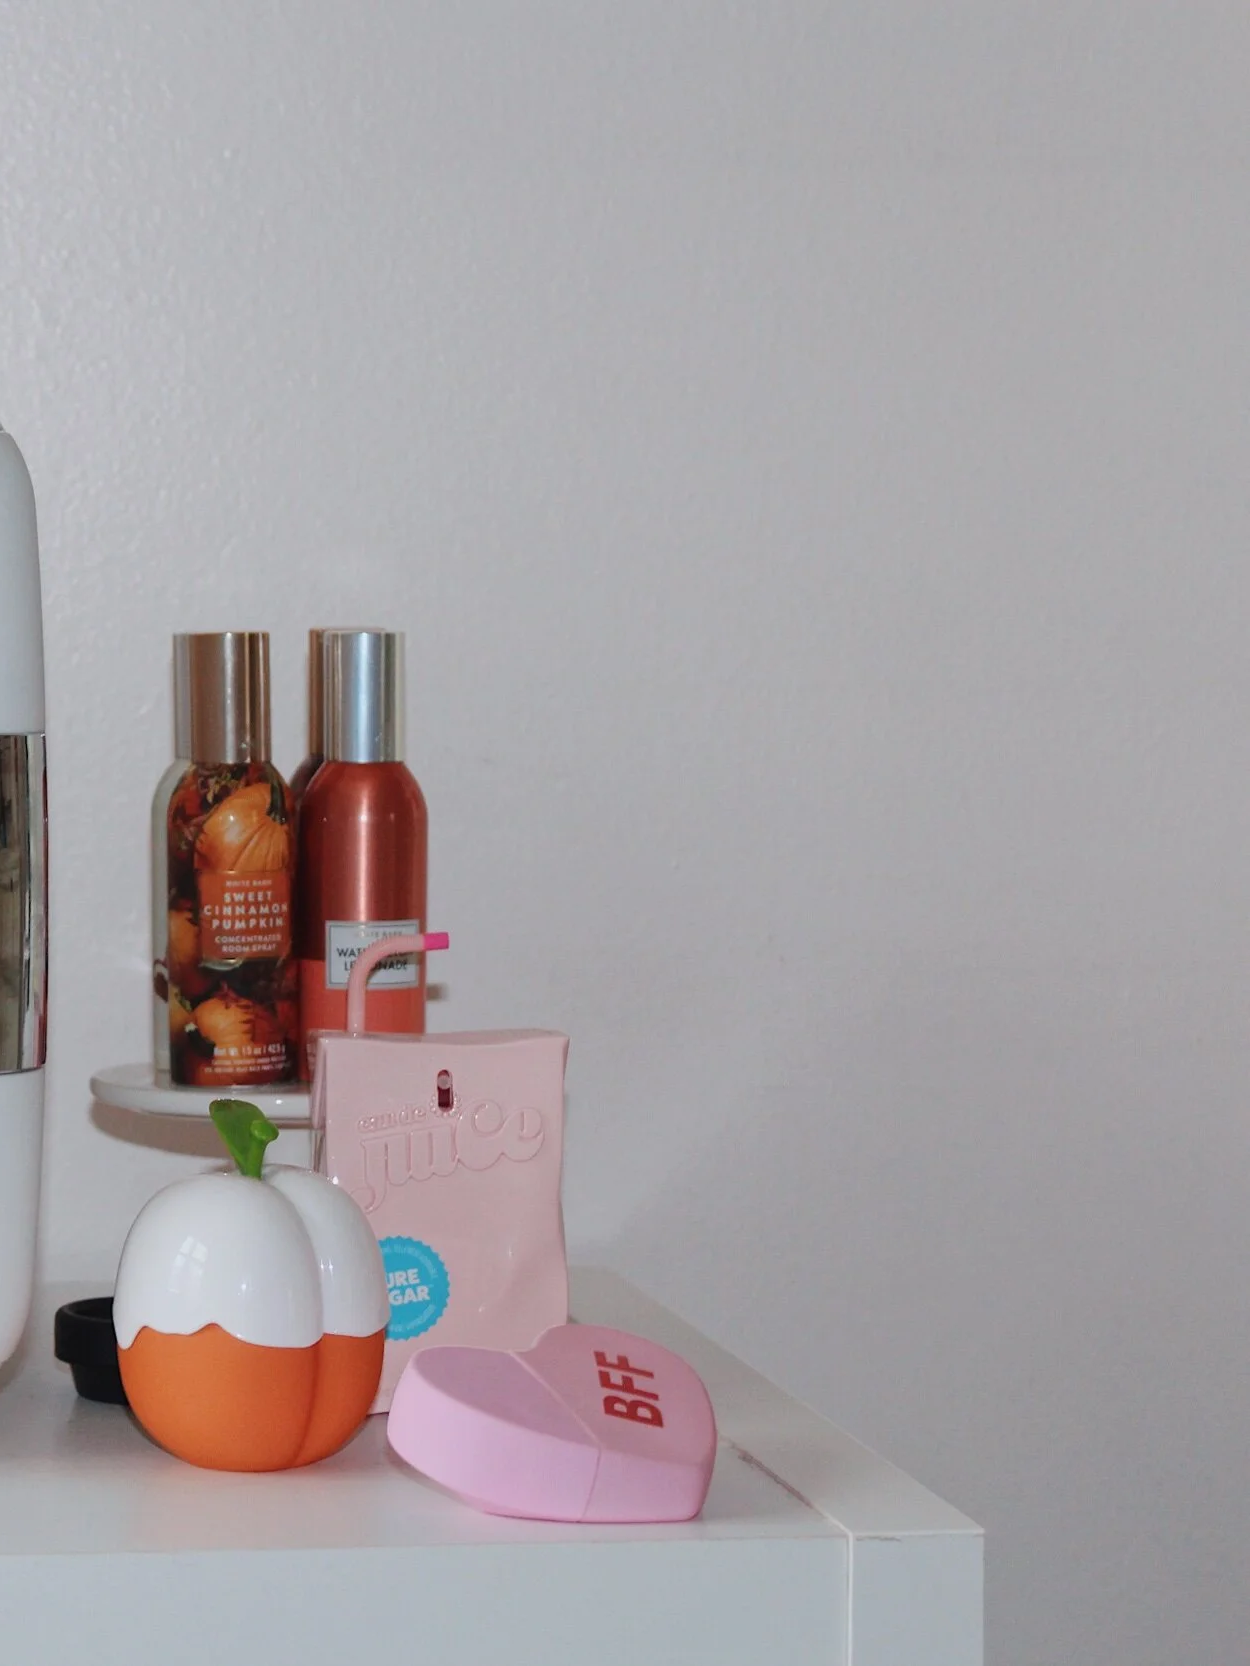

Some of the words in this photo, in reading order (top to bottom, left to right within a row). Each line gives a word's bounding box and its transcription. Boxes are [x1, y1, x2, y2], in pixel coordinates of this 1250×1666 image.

[223, 891, 272, 903] SWEET
[203, 902, 288, 916] CINNAMON
[212, 917, 284, 930] PUMPKIN
[386, 1268, 420, 1288] URE
[593, 1351, 664, 1428] BFF
